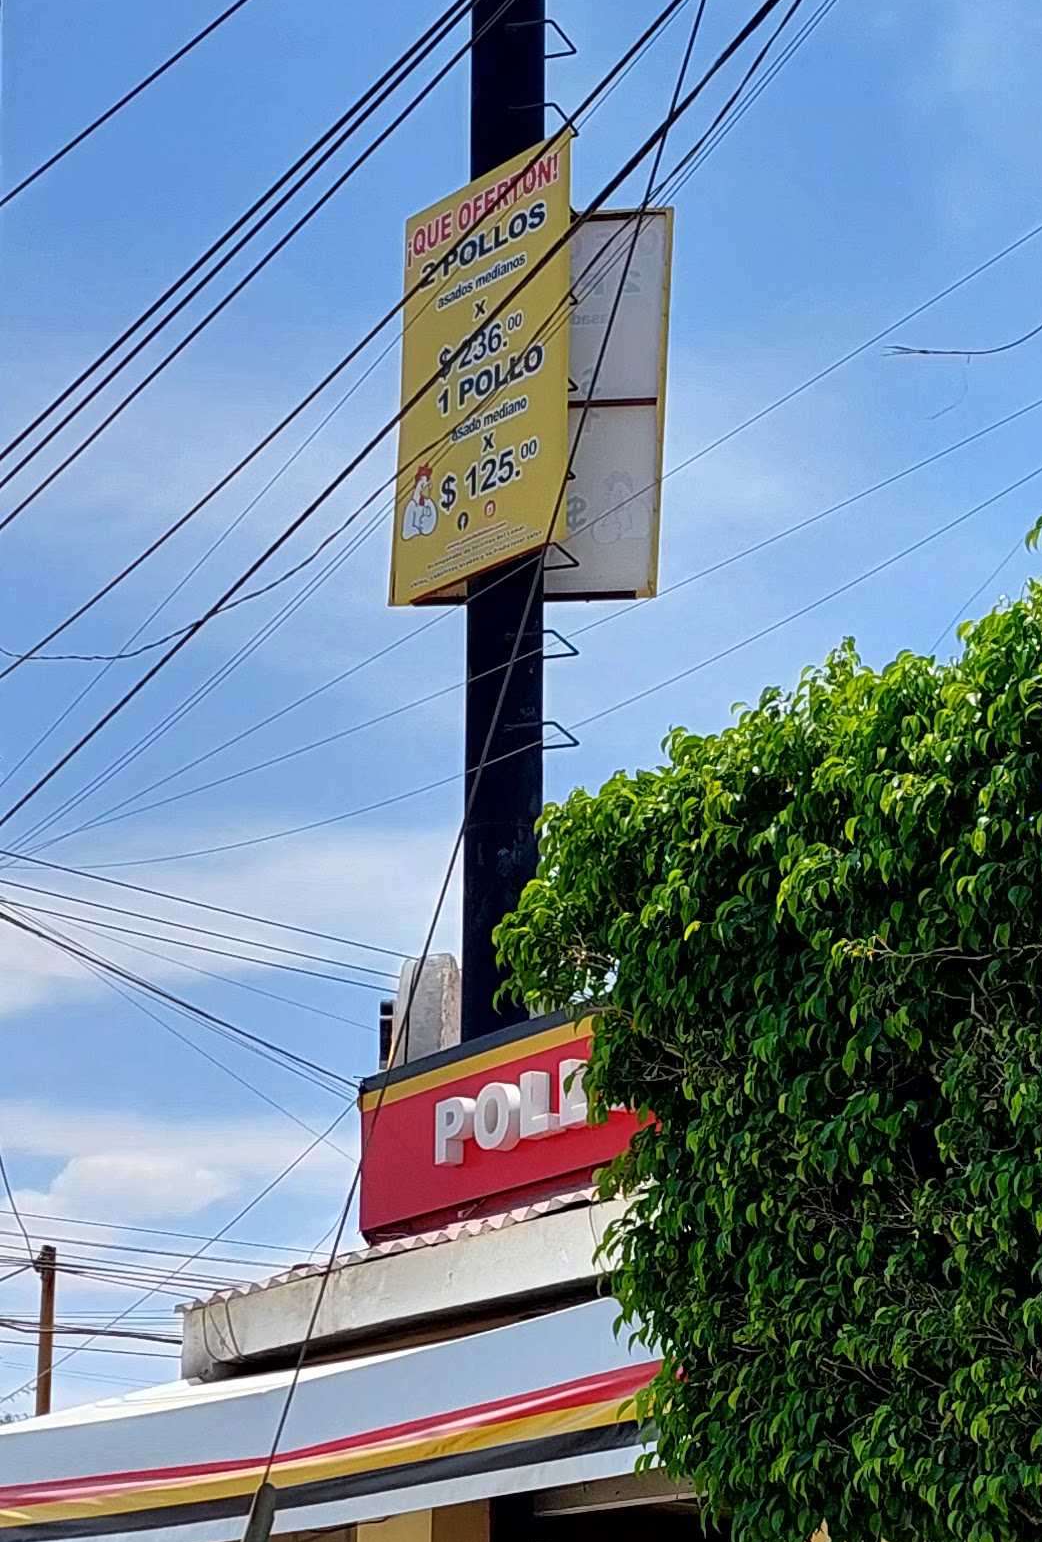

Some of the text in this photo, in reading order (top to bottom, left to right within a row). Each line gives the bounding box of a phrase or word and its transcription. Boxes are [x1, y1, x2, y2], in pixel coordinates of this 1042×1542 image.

[419, 260, 436, 289] 2
[442, 201, 546, 277] POLLOS
[437, 253, 527, 310] asados medianos
[438, 388, 449, 414] 1
[458, 345, 543, 406] POLLO
[451, 396, 528, 442] asado mediano
[435, 1059, 592, 1165] POLL
